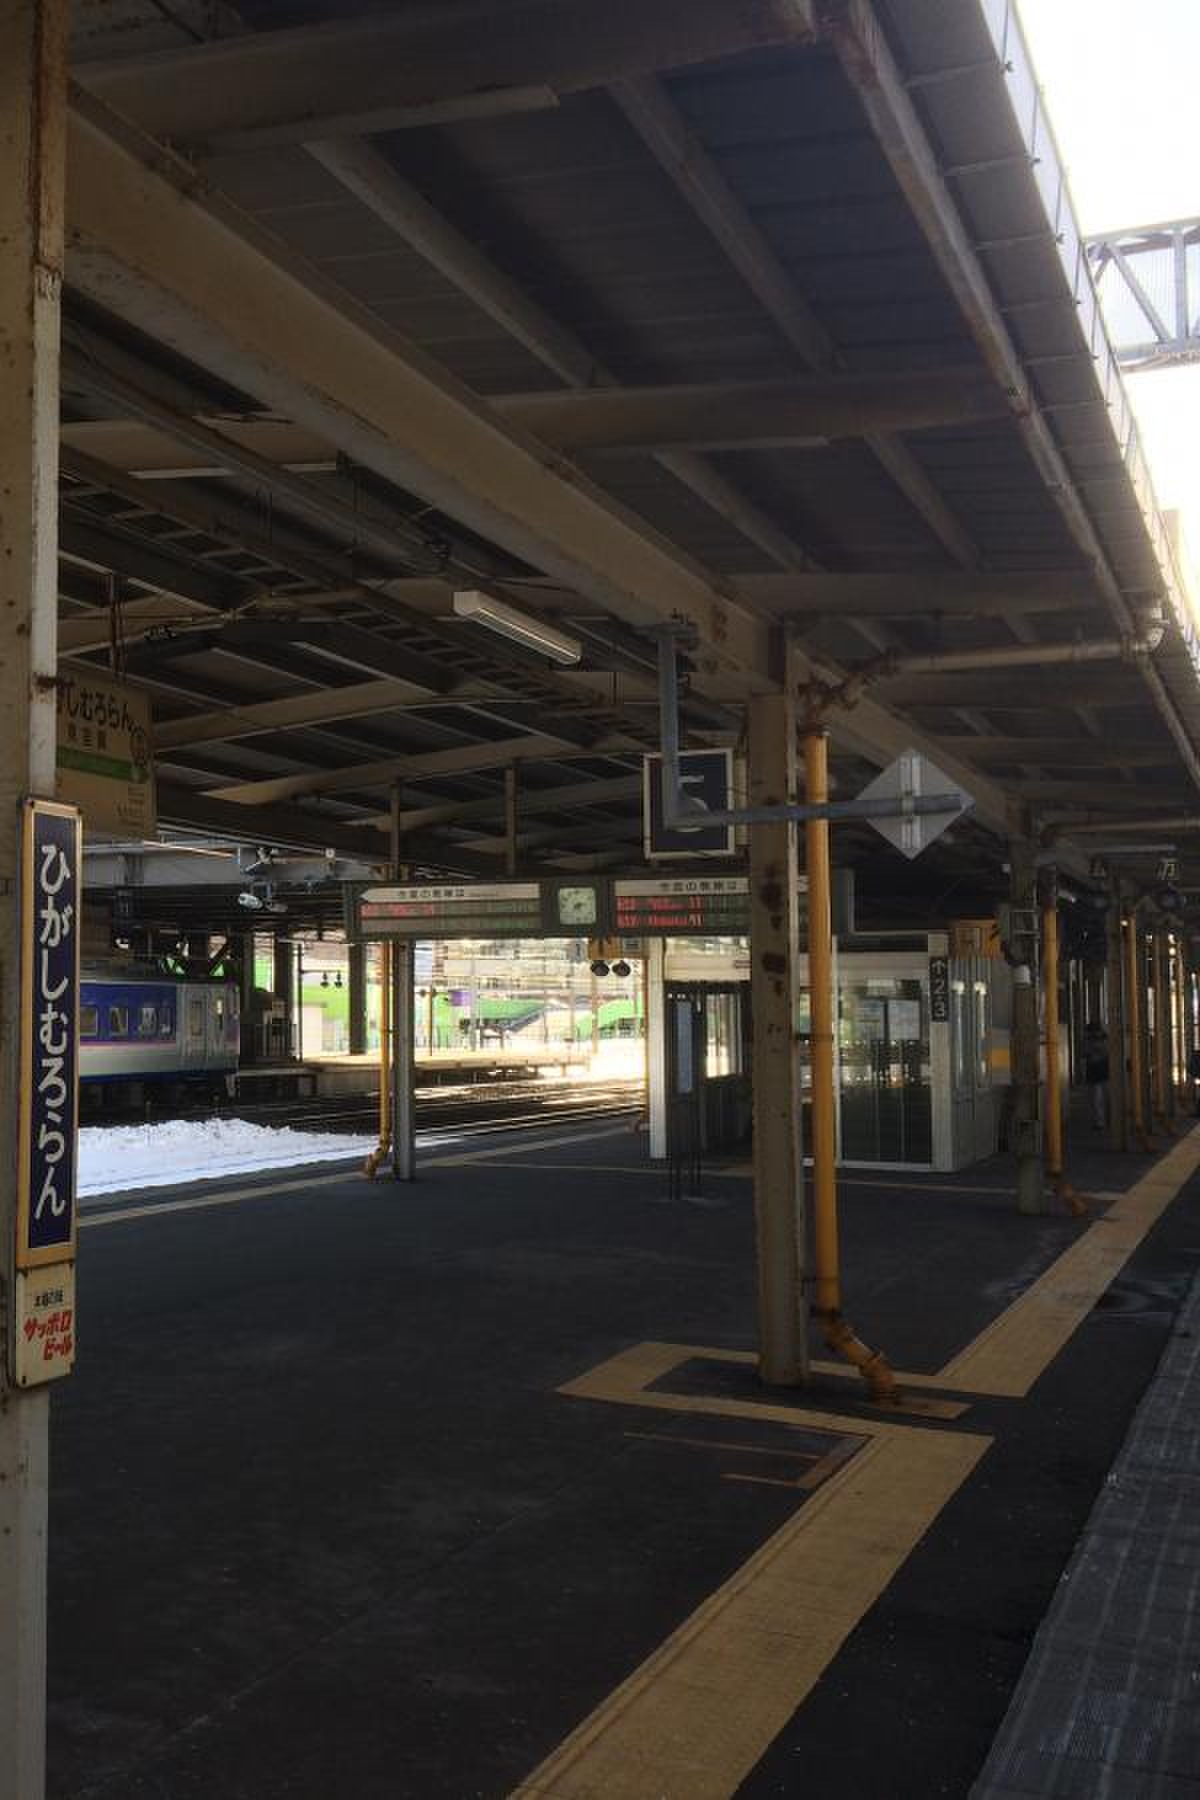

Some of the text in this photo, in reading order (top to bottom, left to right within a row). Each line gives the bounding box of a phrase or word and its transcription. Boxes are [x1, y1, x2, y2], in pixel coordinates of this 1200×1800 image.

[35, 844, 73, 1220] ひがしむろらん
[23, 1309, 73, 1342] サッポロ
